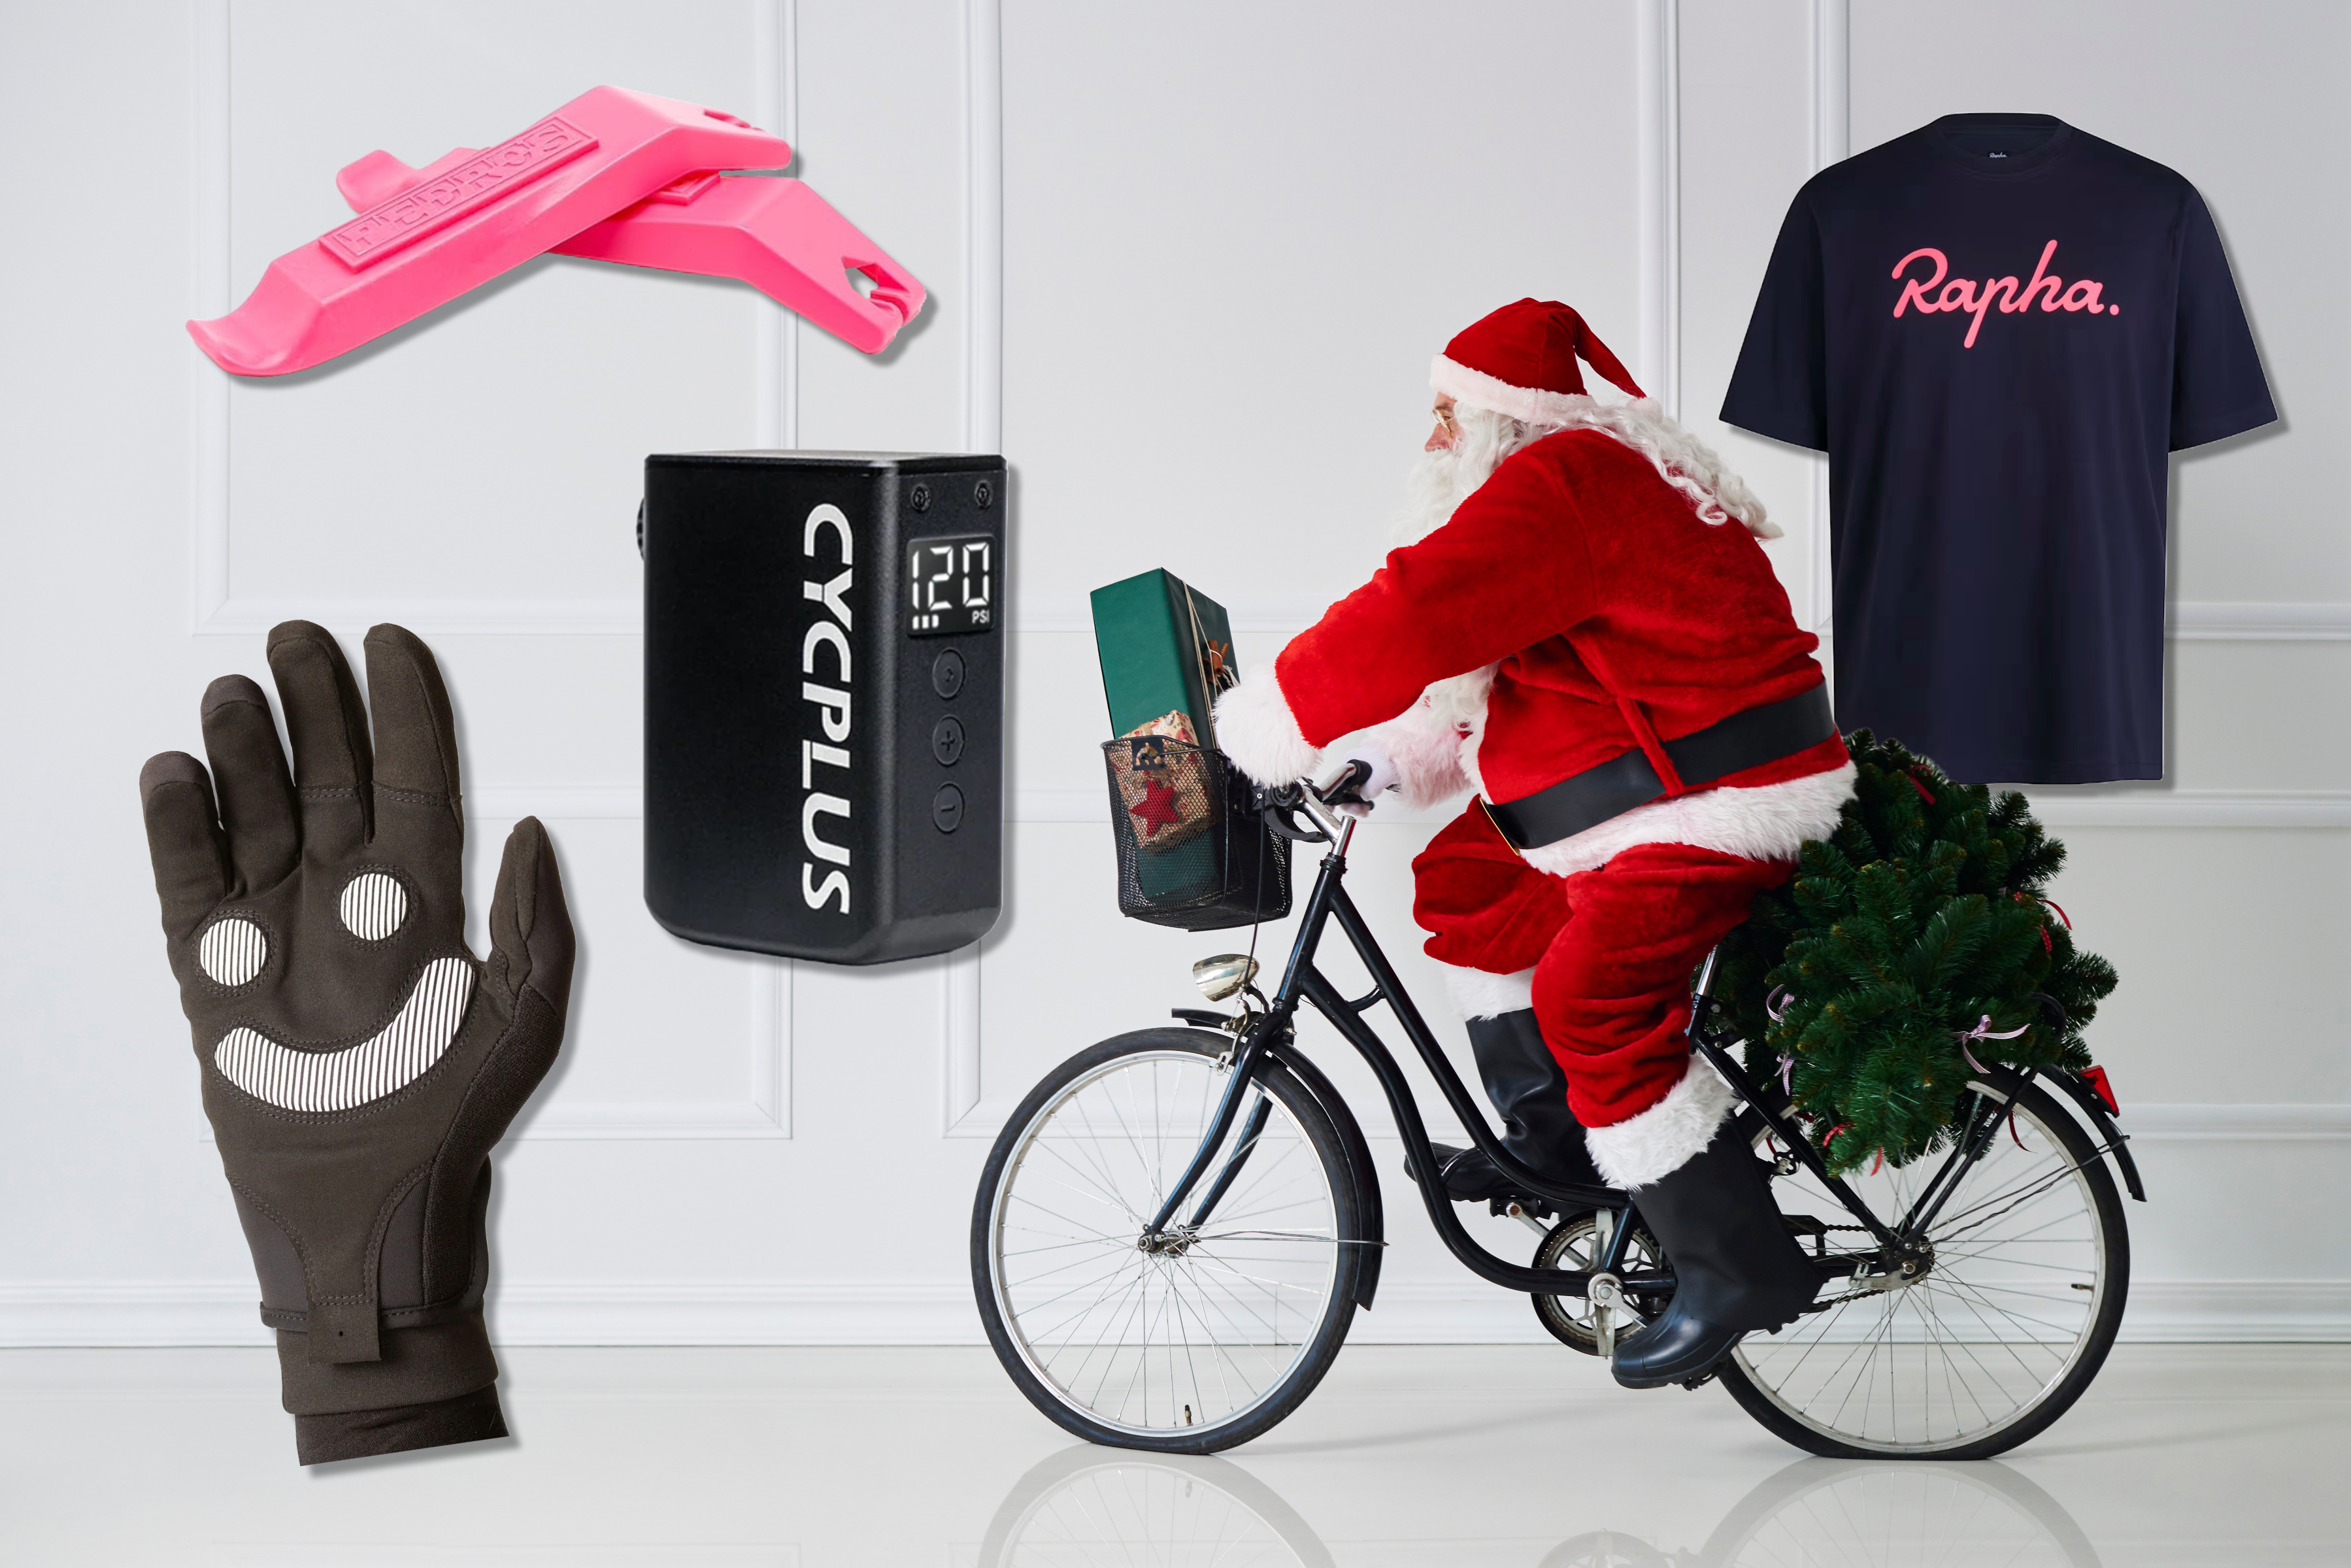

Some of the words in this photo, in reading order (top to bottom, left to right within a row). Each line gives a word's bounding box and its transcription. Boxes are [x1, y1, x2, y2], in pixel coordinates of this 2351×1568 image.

[1892, 239, 2120, 349] Rapha.
[912, 542, 990, 610] 120
[972, 609, 990, 624] PSI
[802, 503, 853, 914] CYCPLUS
